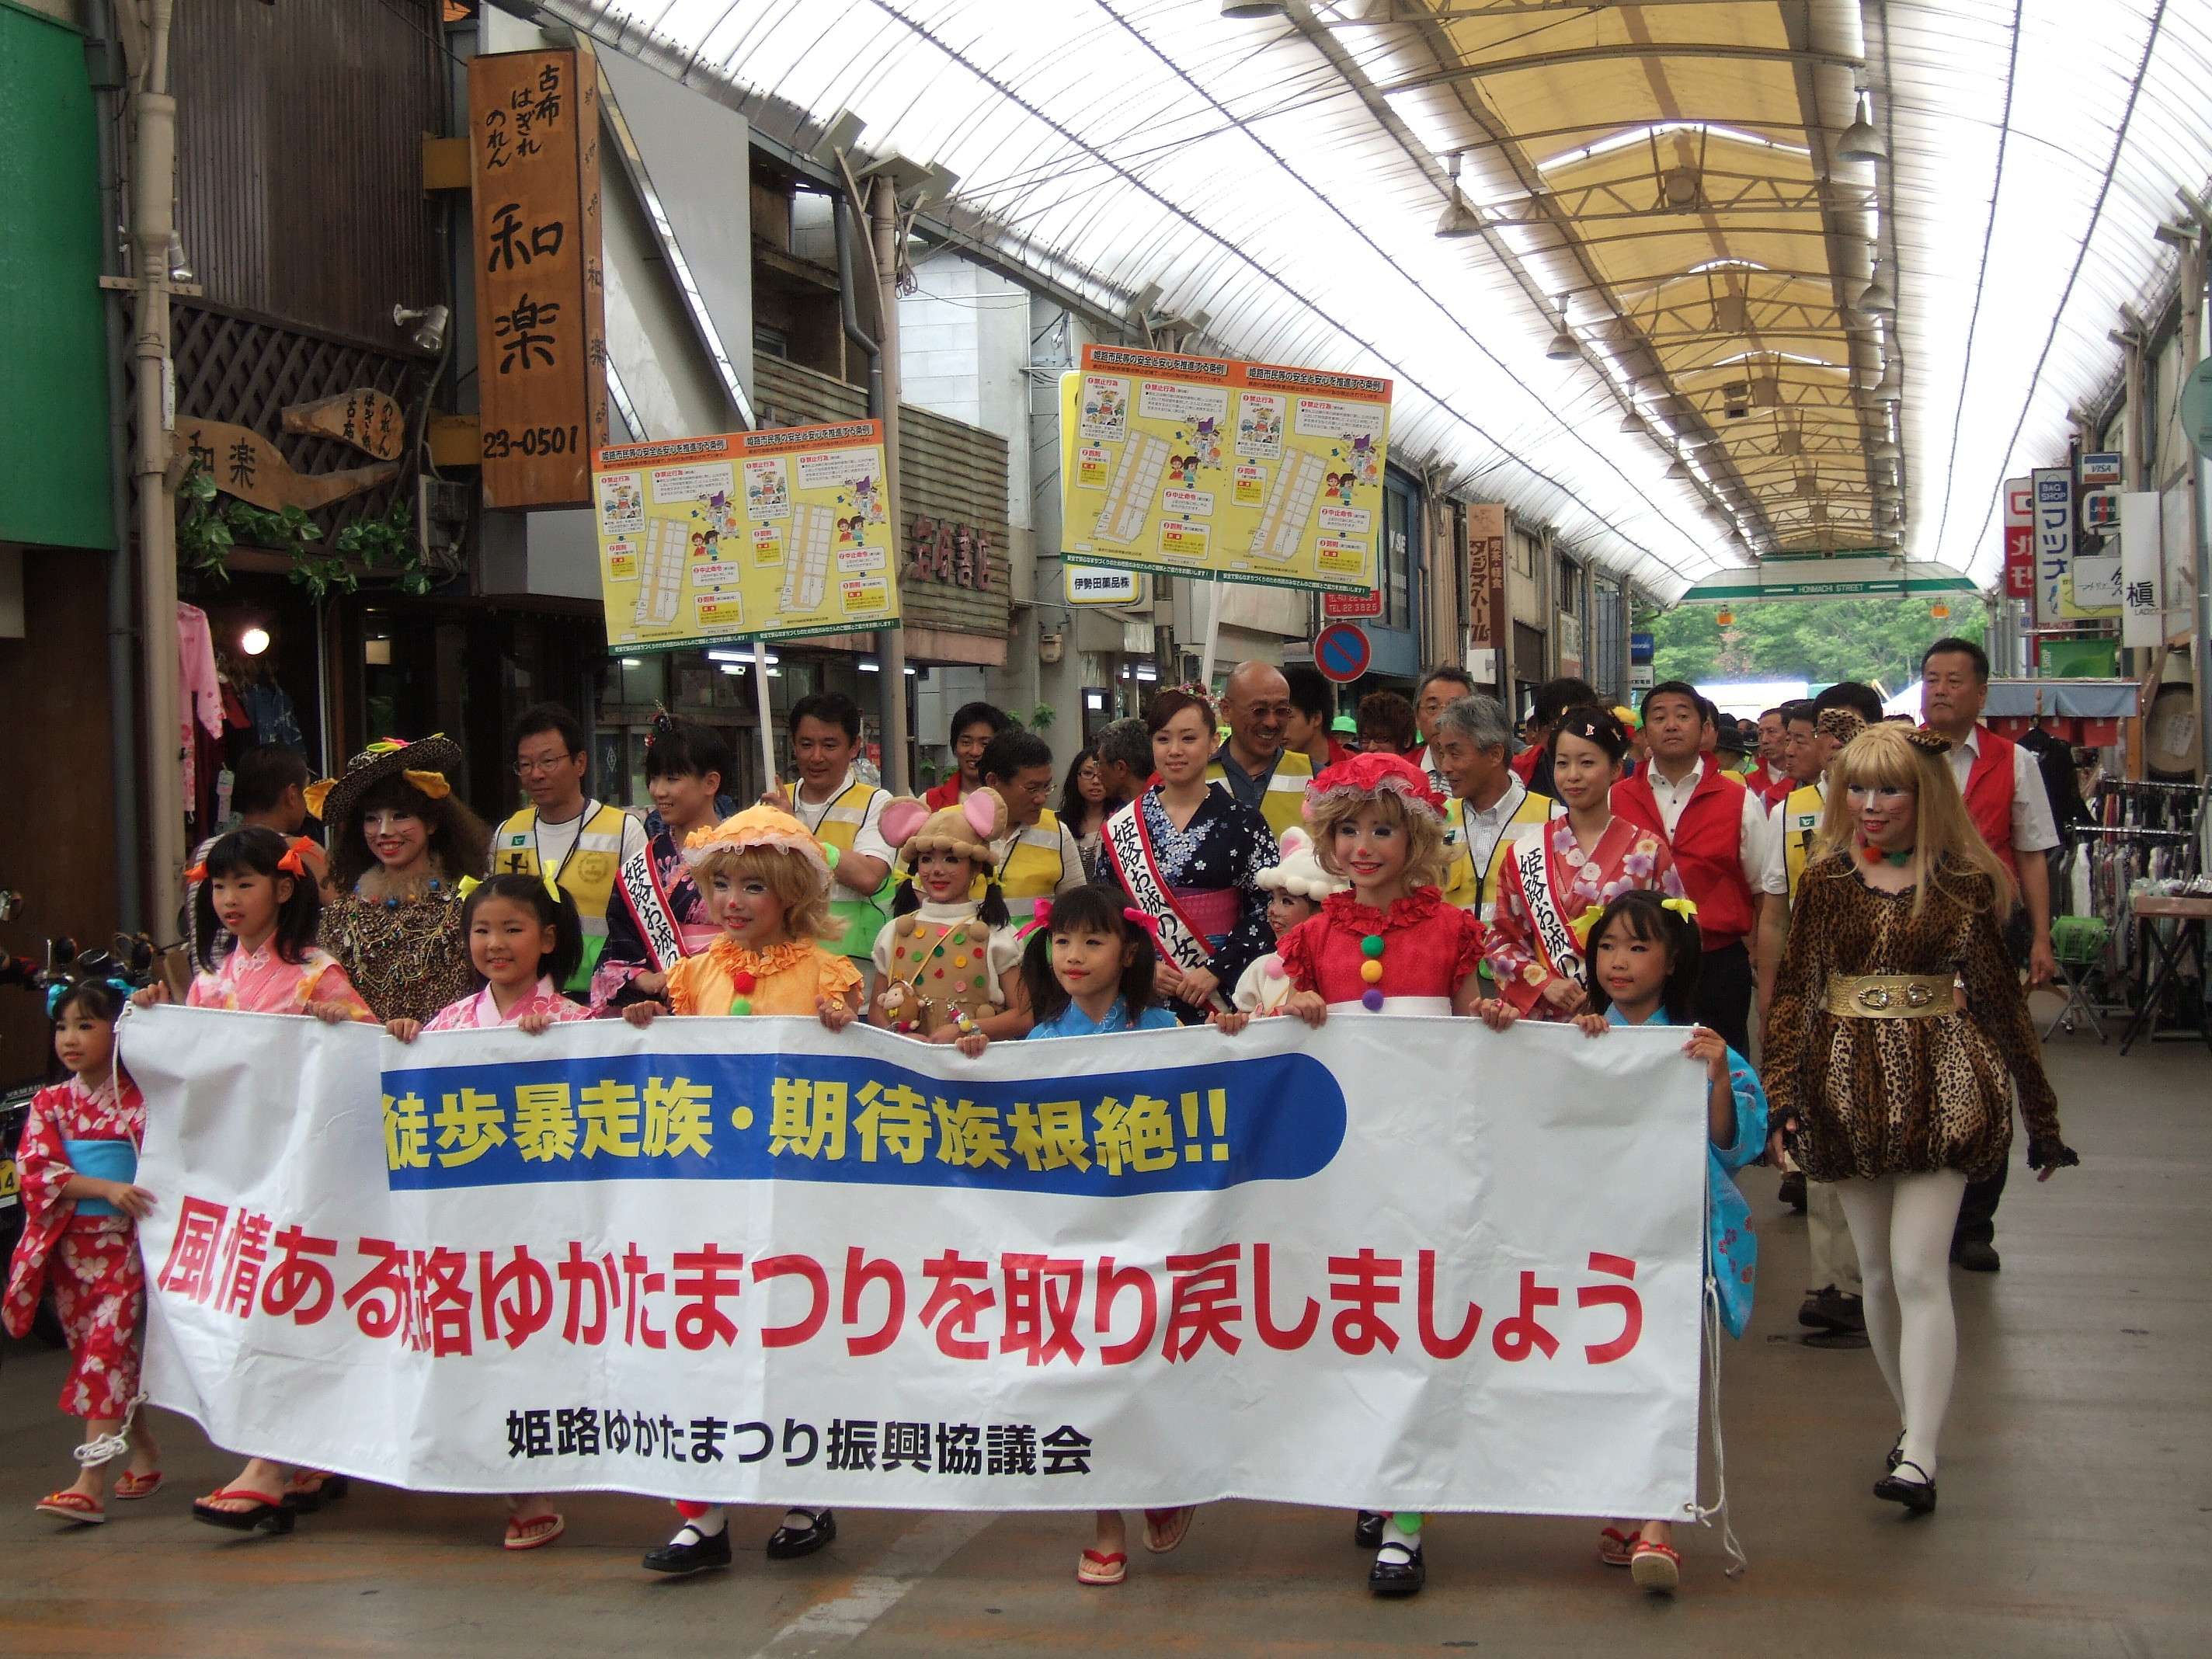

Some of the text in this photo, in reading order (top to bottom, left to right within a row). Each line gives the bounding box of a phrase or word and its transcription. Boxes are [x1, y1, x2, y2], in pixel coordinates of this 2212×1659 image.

[511, 88, 543, 157] はぎれ
[535, 64, 561, 127] 古布
[486, 110, 512, 169] のれん
[488, 203, 564, 374] 和楽
[2041, 492, 2066, 501] SHOP
[2042, 484, 2061, 492] BAG
[157, 1195, 1643, 1367] 風情ある路ゆかたまつりを取り戻しましょう
[506, 1405, 1094, 1476] 姫路ゆかたまつり振興協議会
